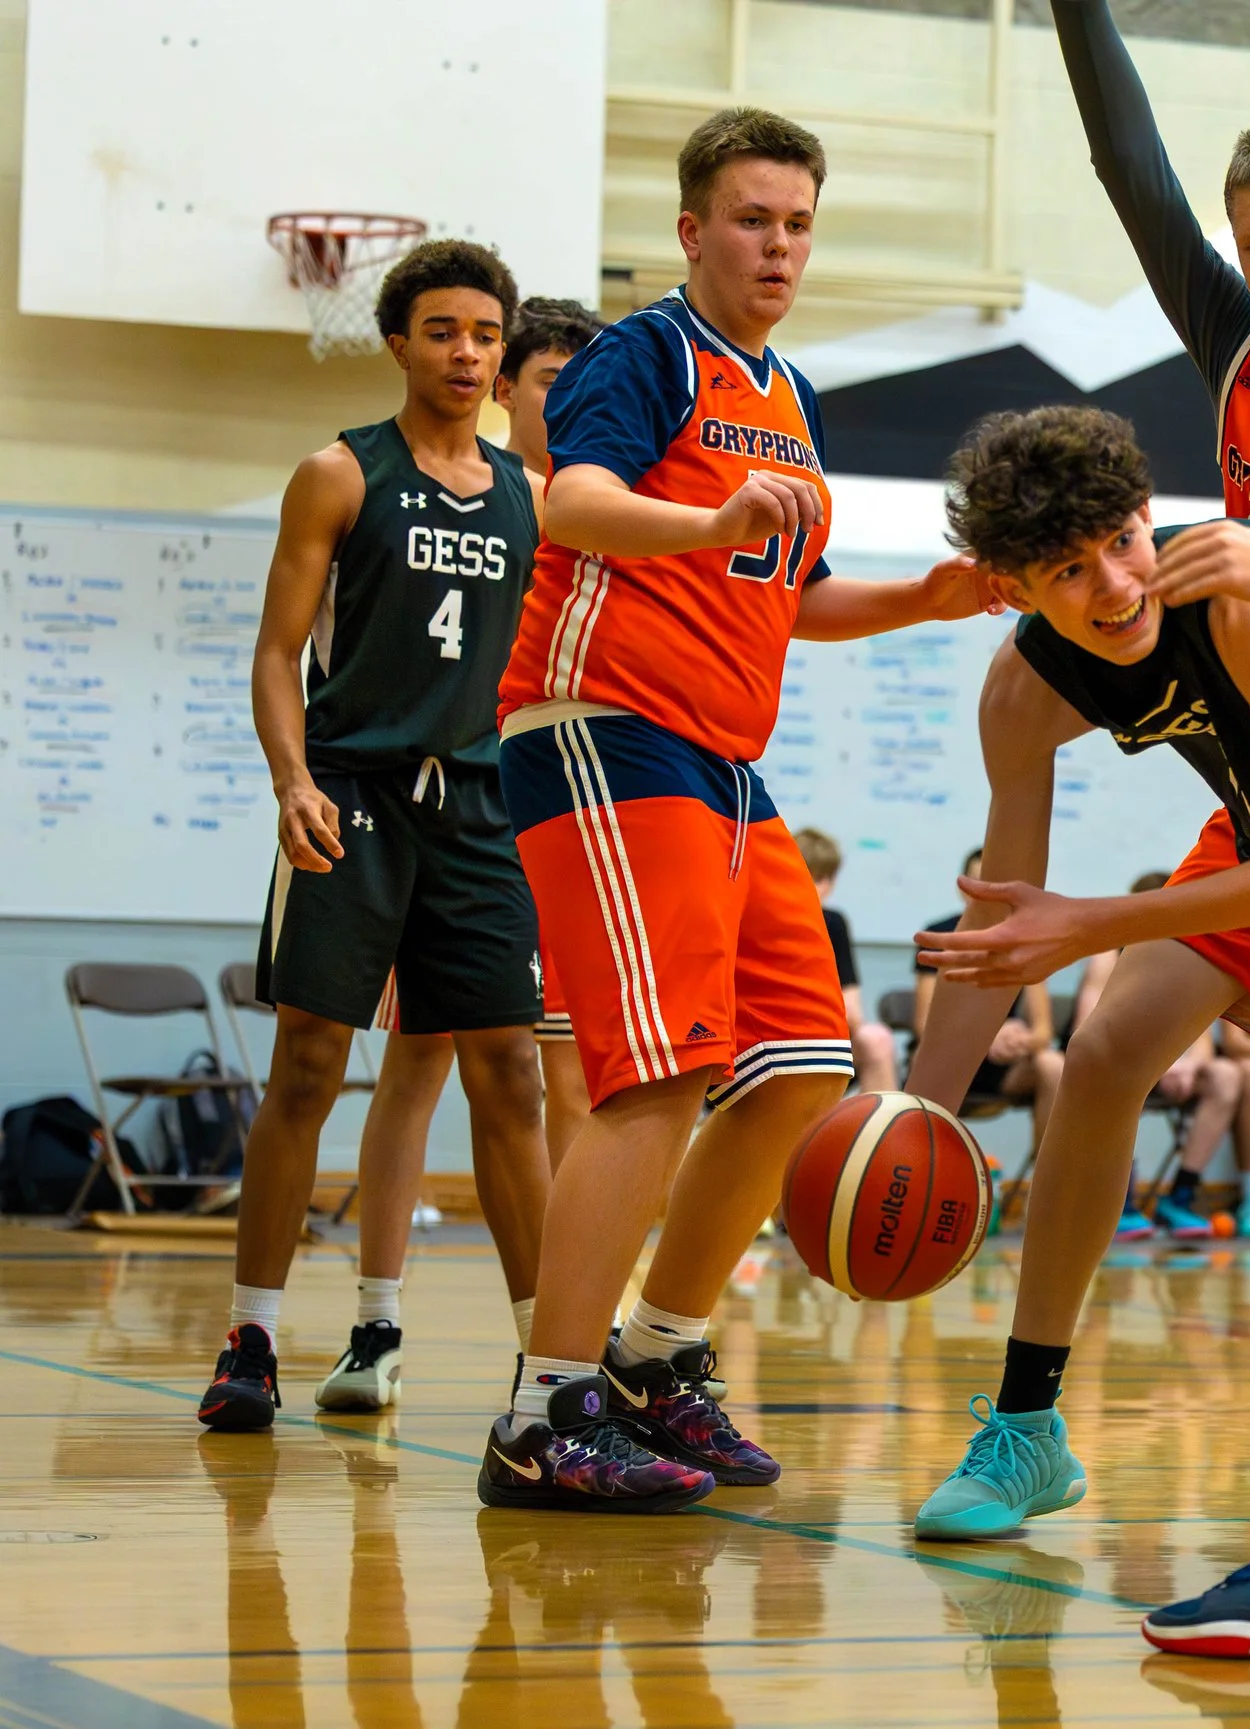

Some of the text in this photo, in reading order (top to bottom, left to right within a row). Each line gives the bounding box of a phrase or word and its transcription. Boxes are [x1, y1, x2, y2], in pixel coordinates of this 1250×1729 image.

[407, 526, 507, 580] GESS
[428, 589, 463, 660] 4
[873, 1165, 912, 1257] molten
[932, 1200, 958, 1244] FIBA
